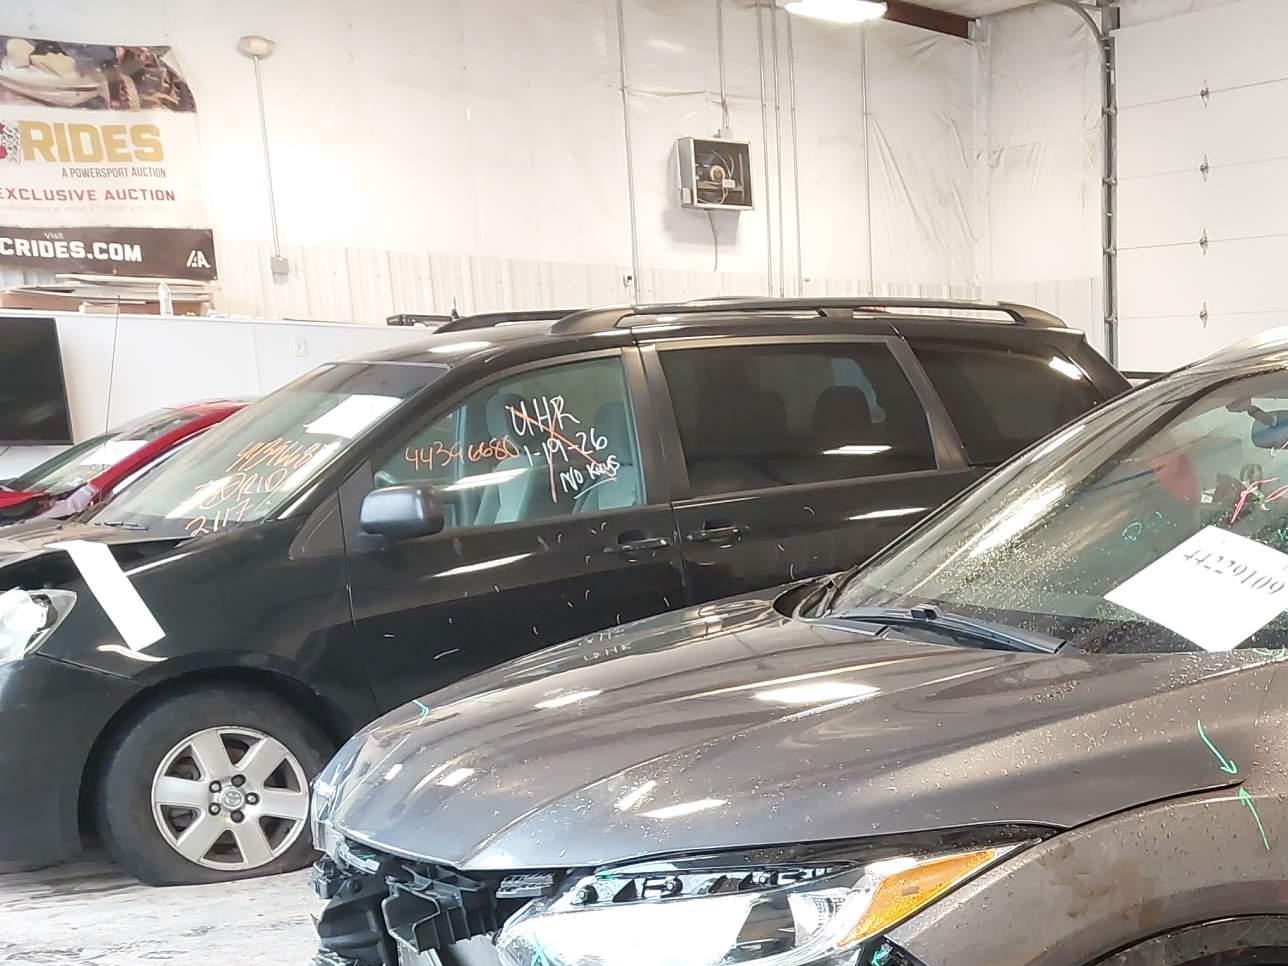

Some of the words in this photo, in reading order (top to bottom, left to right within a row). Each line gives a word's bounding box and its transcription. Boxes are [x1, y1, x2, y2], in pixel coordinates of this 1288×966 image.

[19, 120, 164, 163] RIDES
[61, 167, 68, 178] A
[70, 167, 129, 178] POWERSPORT
[131, 167, 166, 178] AUCTION
[104, 188, 176, 201] AUCTION
[44, 232, 64, 240] Visit
[1183, 550, 1286, 595] 44229109
